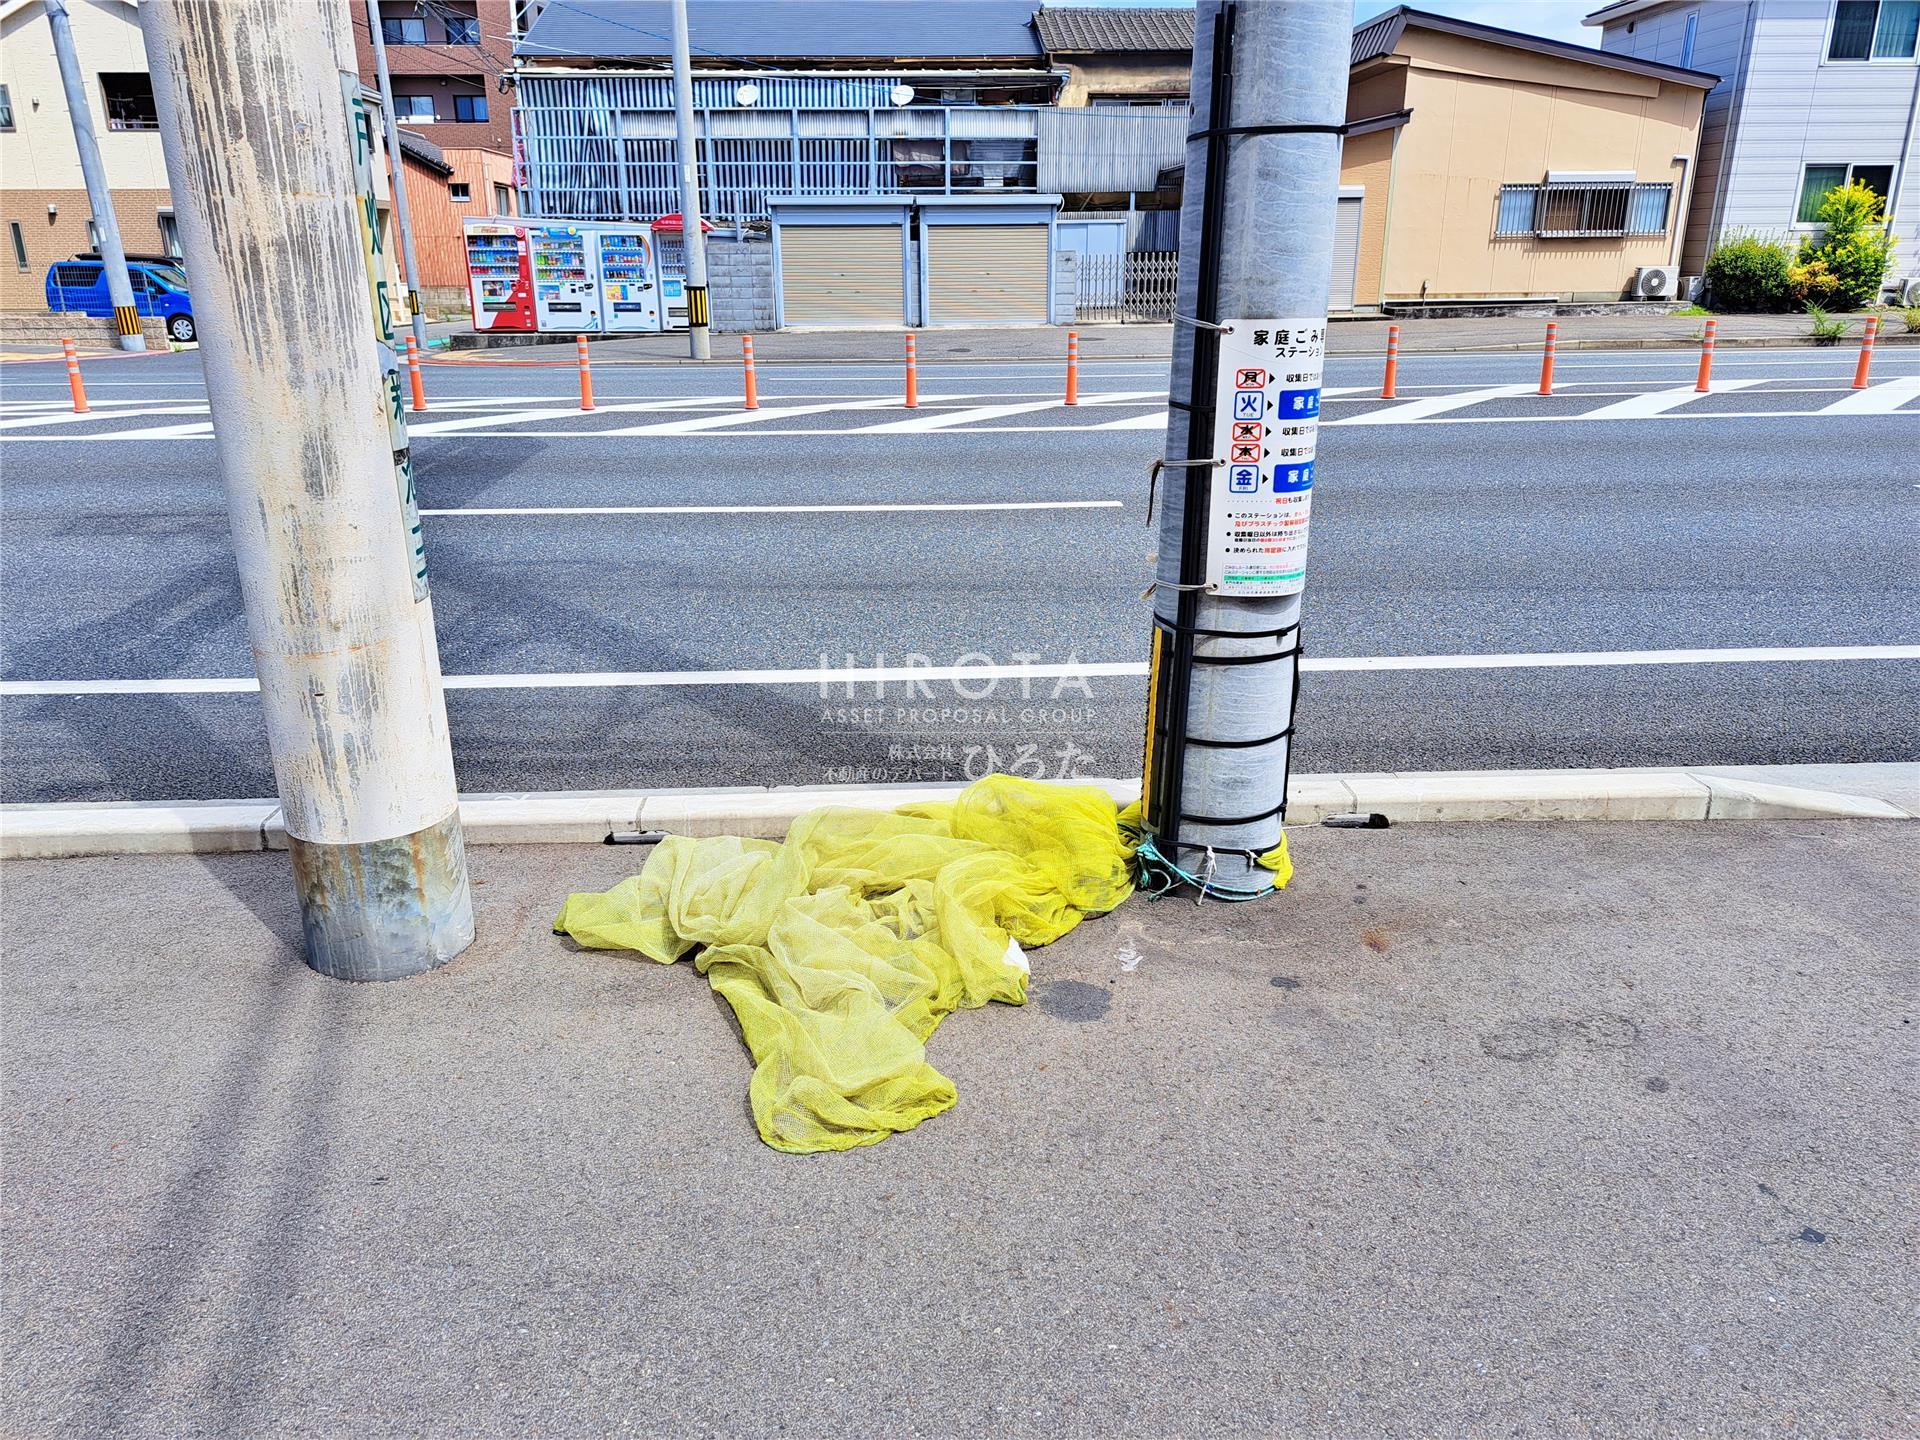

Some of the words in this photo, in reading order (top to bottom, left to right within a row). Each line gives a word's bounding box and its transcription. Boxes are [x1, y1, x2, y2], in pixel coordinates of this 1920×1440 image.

[1253, 329, 1325, 346] 家庭ごみ
[1243, 372, 1257, 383] 月
[1240, 395, 1258, 413] 火
[1240, 425, 1254, 436] 水
[1239, 446, 1252, 457] 木
[1236, 469, 1252, 486] 金
